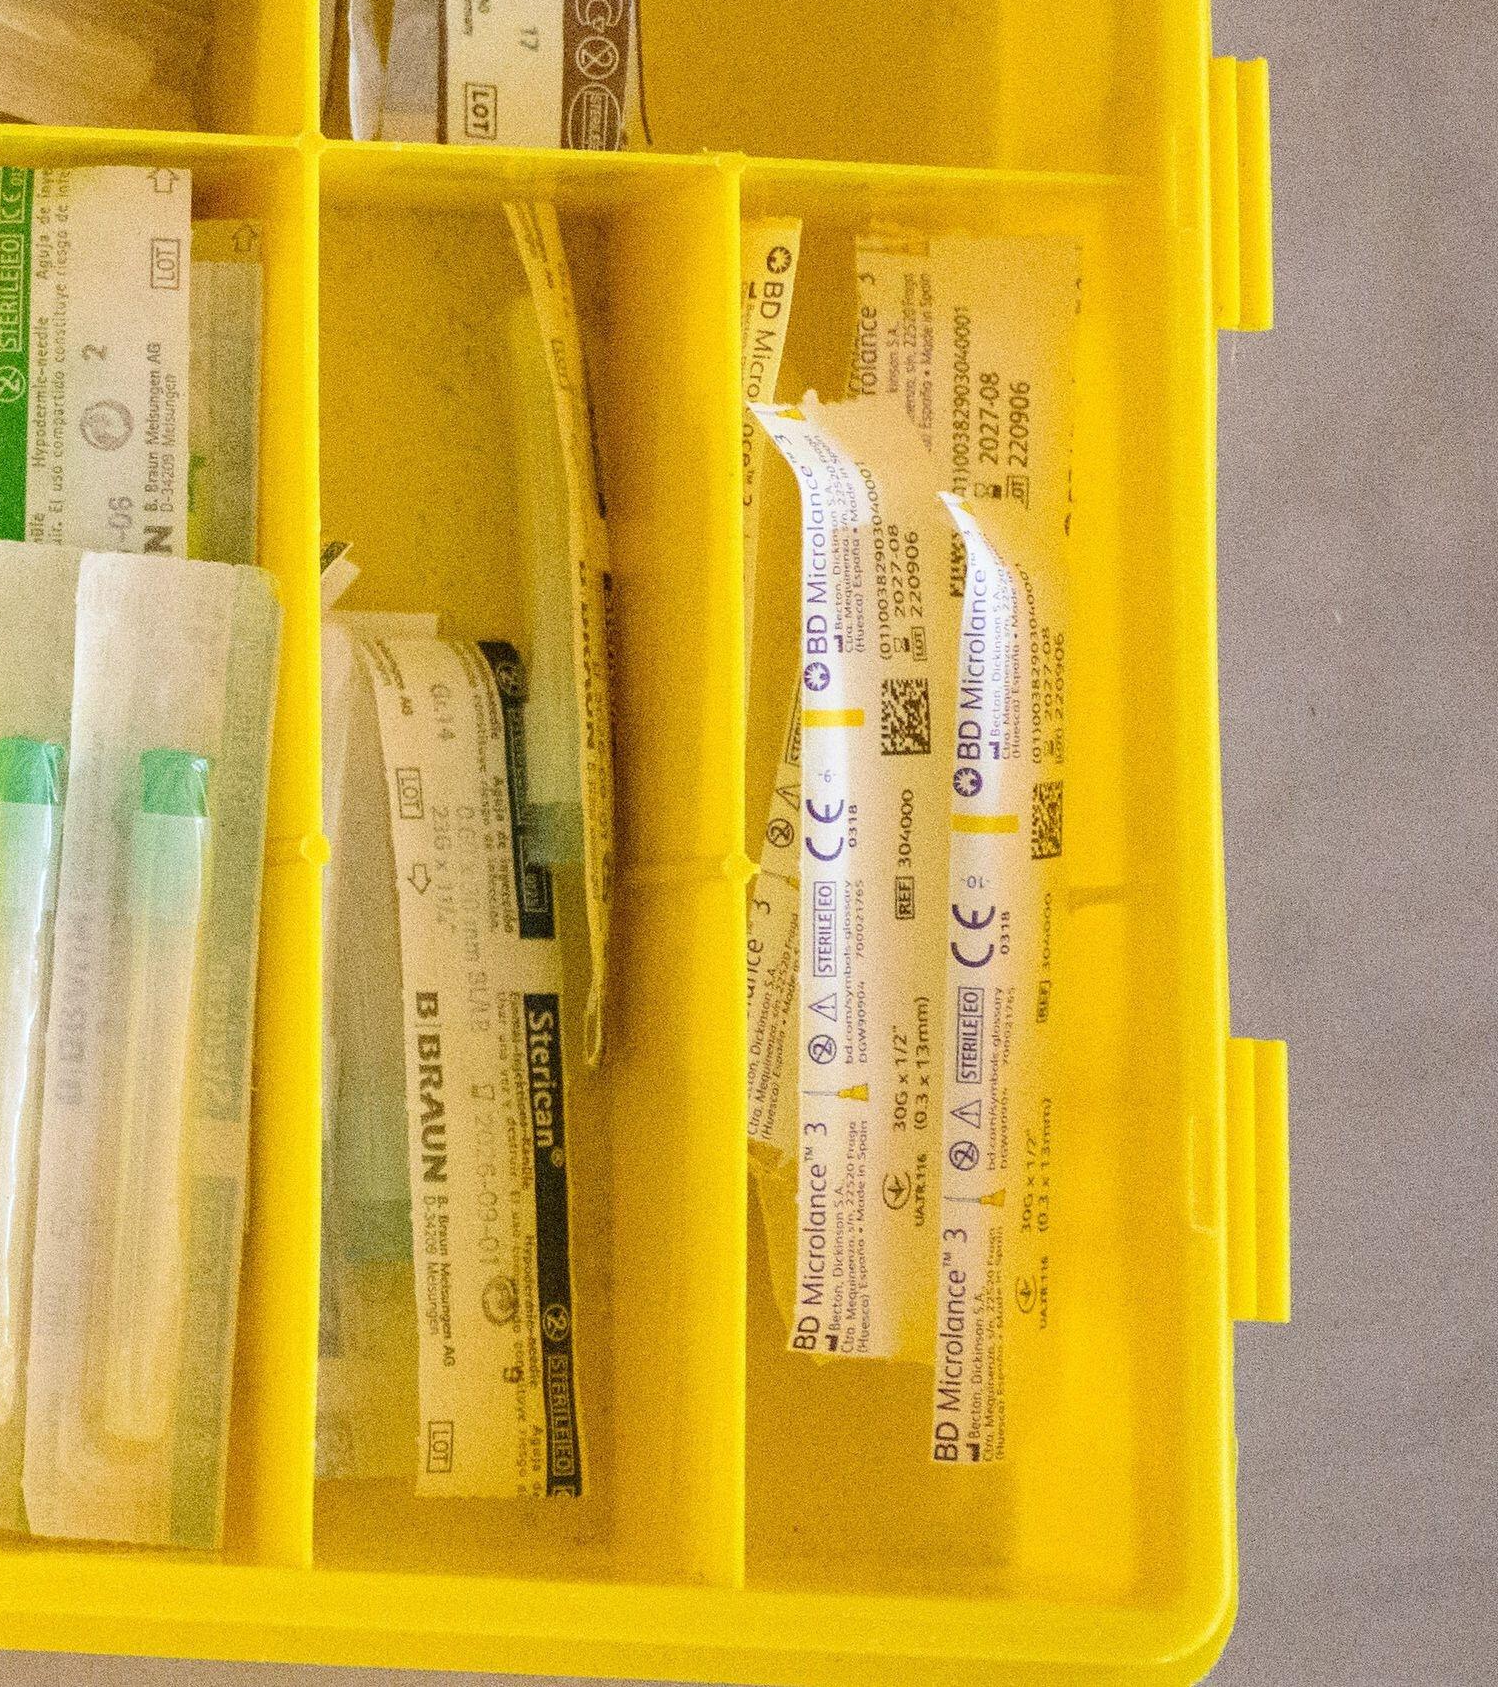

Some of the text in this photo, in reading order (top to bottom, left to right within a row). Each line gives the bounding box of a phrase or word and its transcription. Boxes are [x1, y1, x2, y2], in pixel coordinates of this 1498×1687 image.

[470, 89, 490, 130] LOT
[156, 247, 173, 280] LOT
[758, 280, 784, 320] BD
[0, 268, 19, 349] STERILE
[52, 283, 67, 362] constituye
[32, 234, 50, 467] Hypodermic-needle Aguja
[82, 344, 105, 360] 2
[918, 326, 935, 428] España Made
[51, 370, 65, 457] compartido
[146, 342, 161, 491] Braun Melsungen AG
[161, 374, 178, 511] D-34209 Melsungen
[977, 371, 1001, 464] 2027-08
[1007, 381, 1030, 467] 220906
[849, 537, 862, 588] España
[886, 523, 905, 618] 2027-08
[904, 530, 922, 617] 220906
[806, 613, 828, 654] BD
[1054, 632, 1064, 719] 220906
[957, 720, 980, 760] BD
[399, 775, 419, 809] LOT
[847, 804, 859, 847] 0318
[897, 788, 913, 914] REF 304000
[817, 884, 834, 973] STERILE EO
[856, 878, 864, 958] 700021765
[998, 911, 1012, 954] 0318
[749, 990, 772, 1056] Dickinson
[959, 990, 979, 1079] STERILE EO
[760, 1029, 788, 1140] (Huesca) España
[913, 996, 930, 1130] (0.3 13mm)
[416, 1033, 446, 1182] BRAUN
[803, 1121, 827, 1135] 3
[893, 1092, 908, 1131] 30G
[846, 1162, 855, 1205] 22520
[830, 1210, 844, 1331] Becton, Dickinson
[942, 1226, 968, 1242] 3
[424, 1261, 440, 1336] Melsungen
[792, 1315, 819, 1350] BD
[856, 1238, 868, 1352] (Huesca) España
[971, 1316, 985, 1383] Dickinson
[430, 1429, 449, 1463] LOT
[932, 1421, 961, 1462] BD
